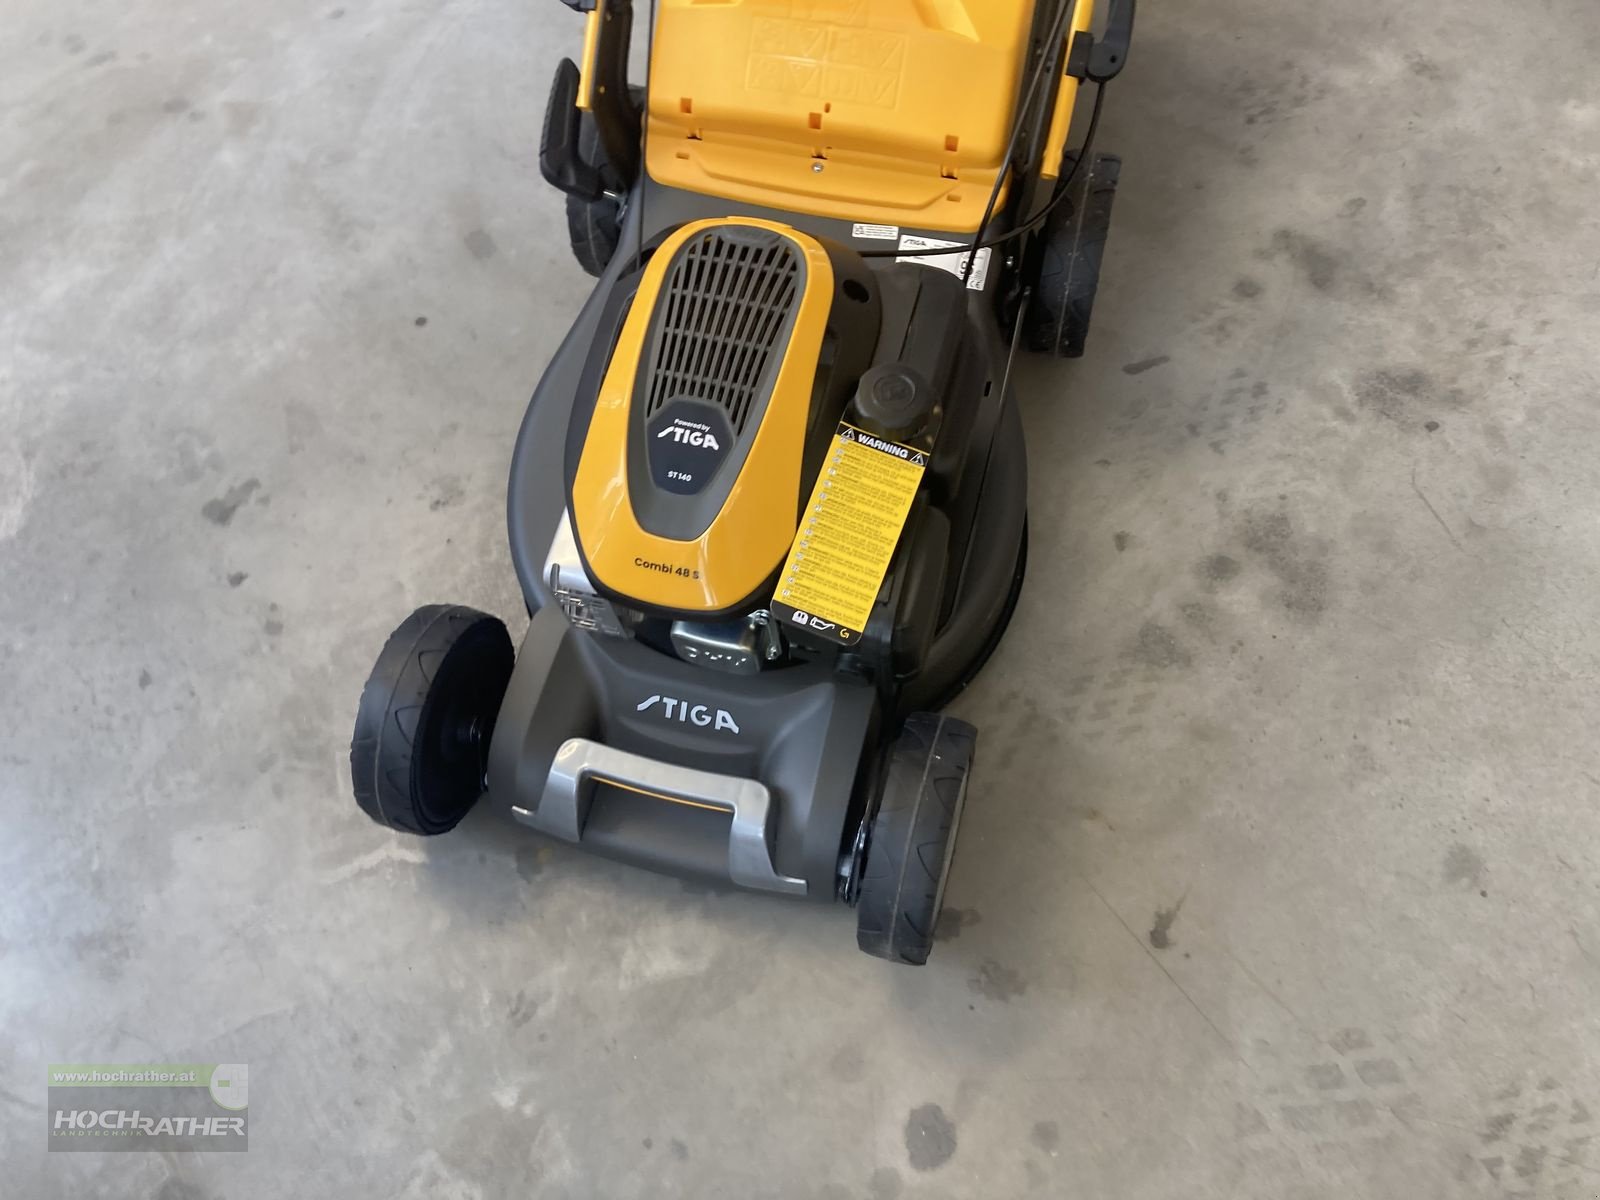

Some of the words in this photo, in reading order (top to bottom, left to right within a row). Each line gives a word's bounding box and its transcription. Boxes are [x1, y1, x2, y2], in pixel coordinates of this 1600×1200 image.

[674, 418, 701, 430] Powered
[701, 423, 711, 433] by
[657, 426, 720, 451] STIGA
[857, 433, 909, 459] WARNING
[667, 470, 679, 479] ST
[678, 472, 693, 482] 140
[634, 557, 673, 575] Combi
[675, 567, 690, 578] 48
[636, 695, 740, 735] STIGA
